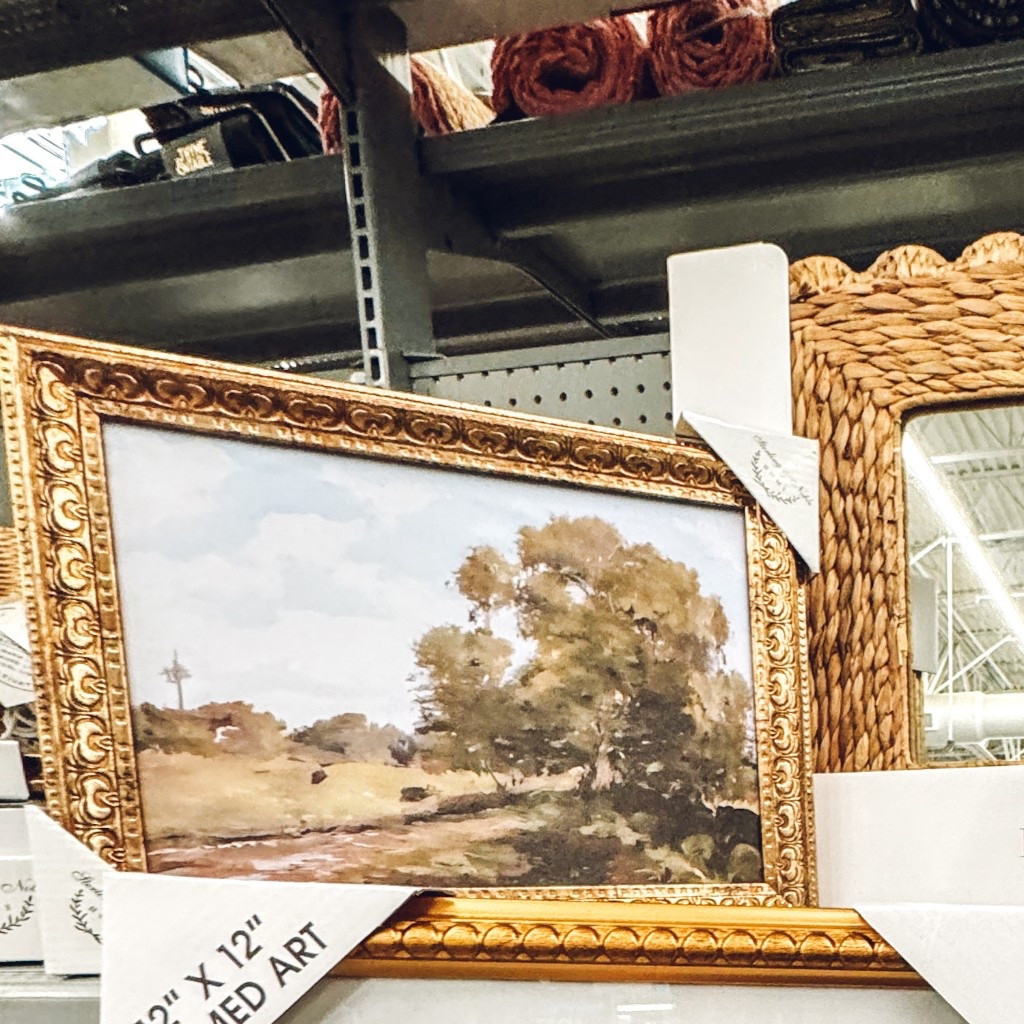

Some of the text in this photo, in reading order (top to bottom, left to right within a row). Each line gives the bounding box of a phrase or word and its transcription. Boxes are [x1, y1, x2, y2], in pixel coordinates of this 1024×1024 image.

[183, 962, 225, 1001] X
[216, 914, 263, 969] 12"
[268, 921, 328, 988] ART
